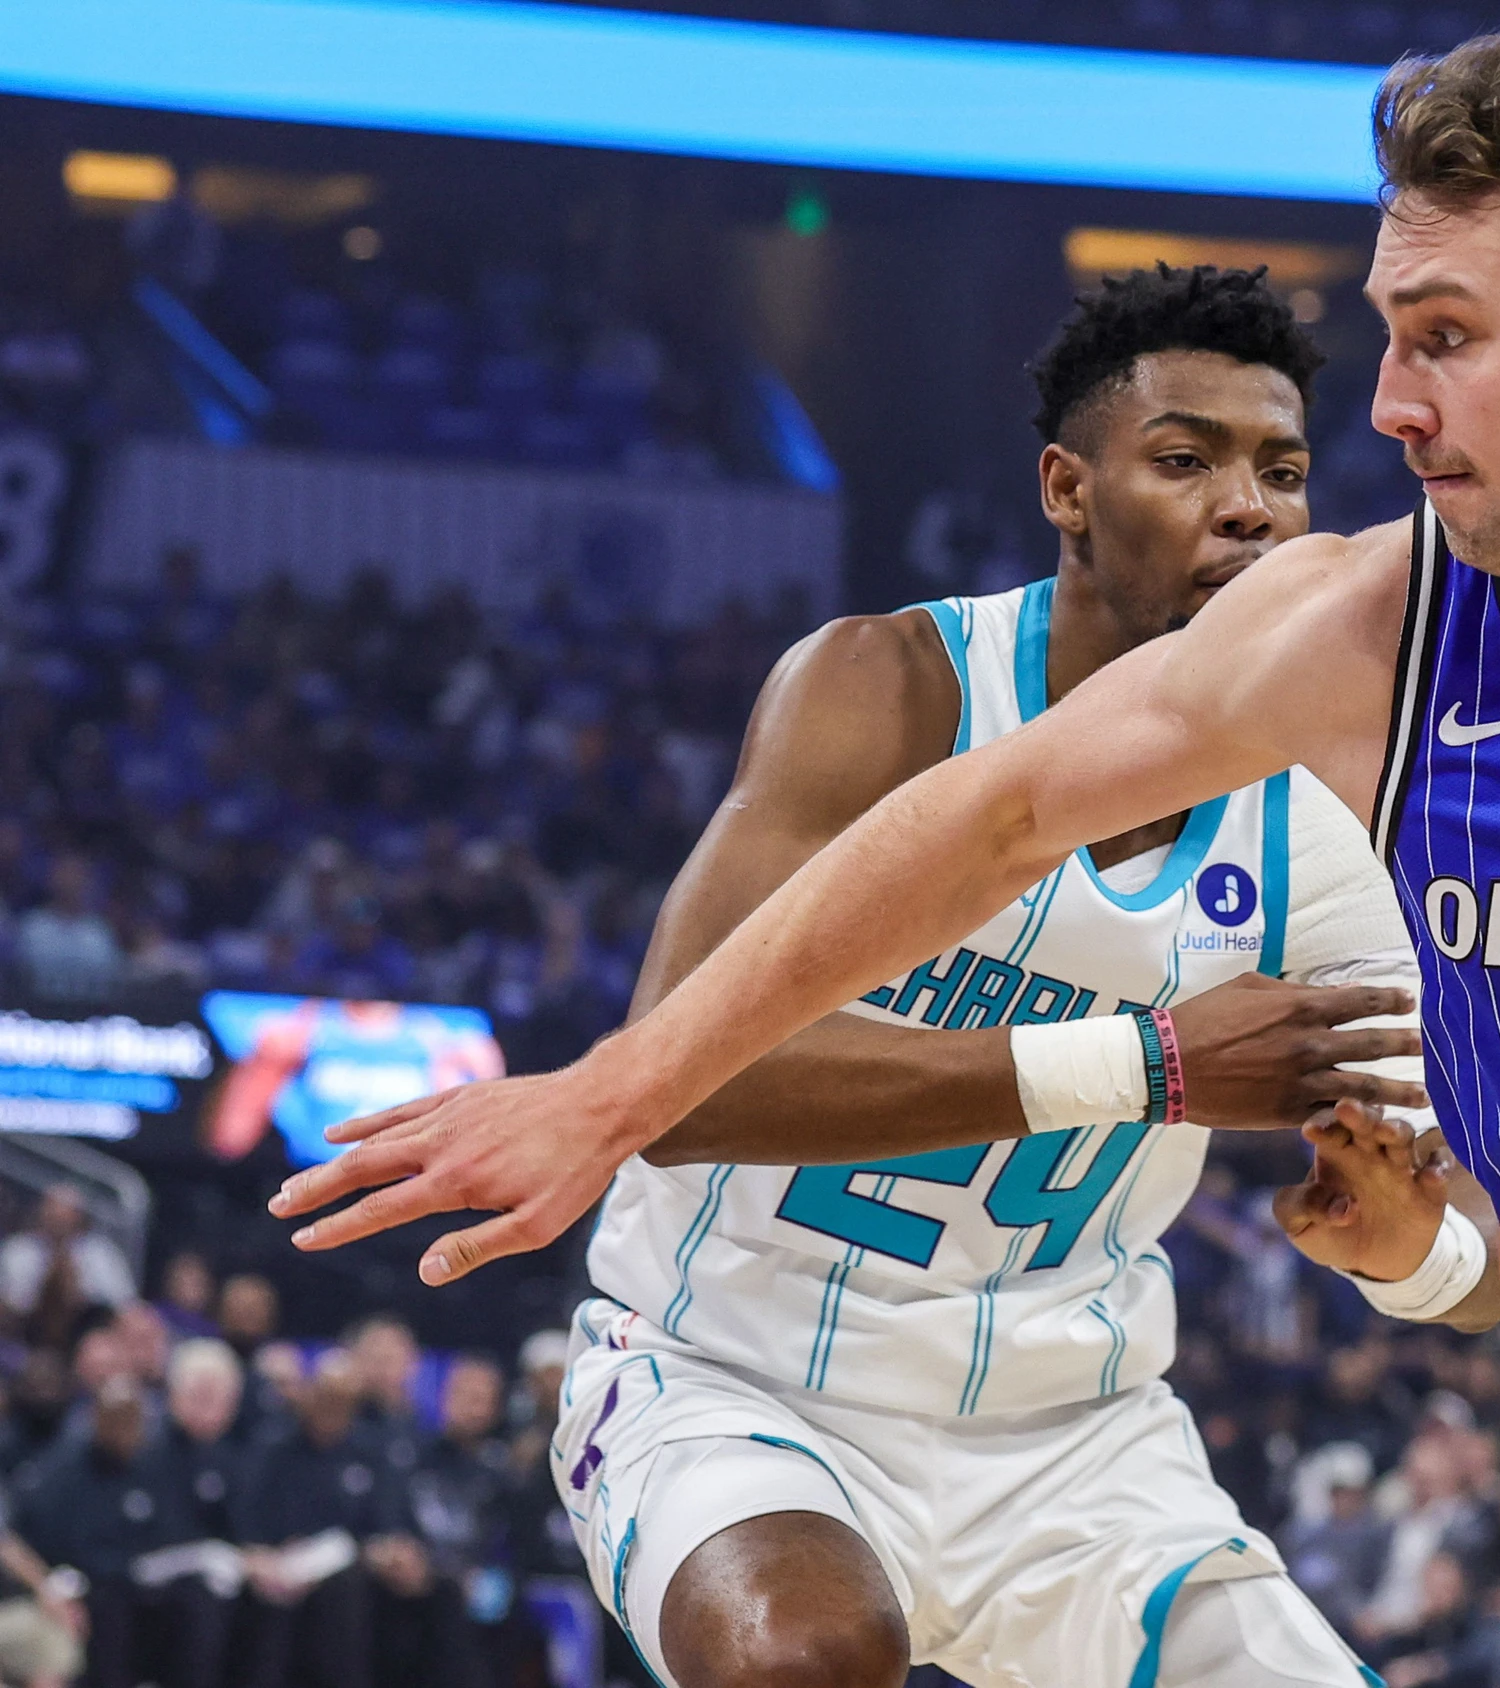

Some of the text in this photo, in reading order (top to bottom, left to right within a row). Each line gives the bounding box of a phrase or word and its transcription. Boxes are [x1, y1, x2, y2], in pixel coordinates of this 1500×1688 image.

[1180, 931, 1221, 950] Judi
[1137, 1014, 1164, 1066] HORNETS
[1161, 1026, 1181, 1086] JESUS
[775, 1121, 1152, 1272] 24
